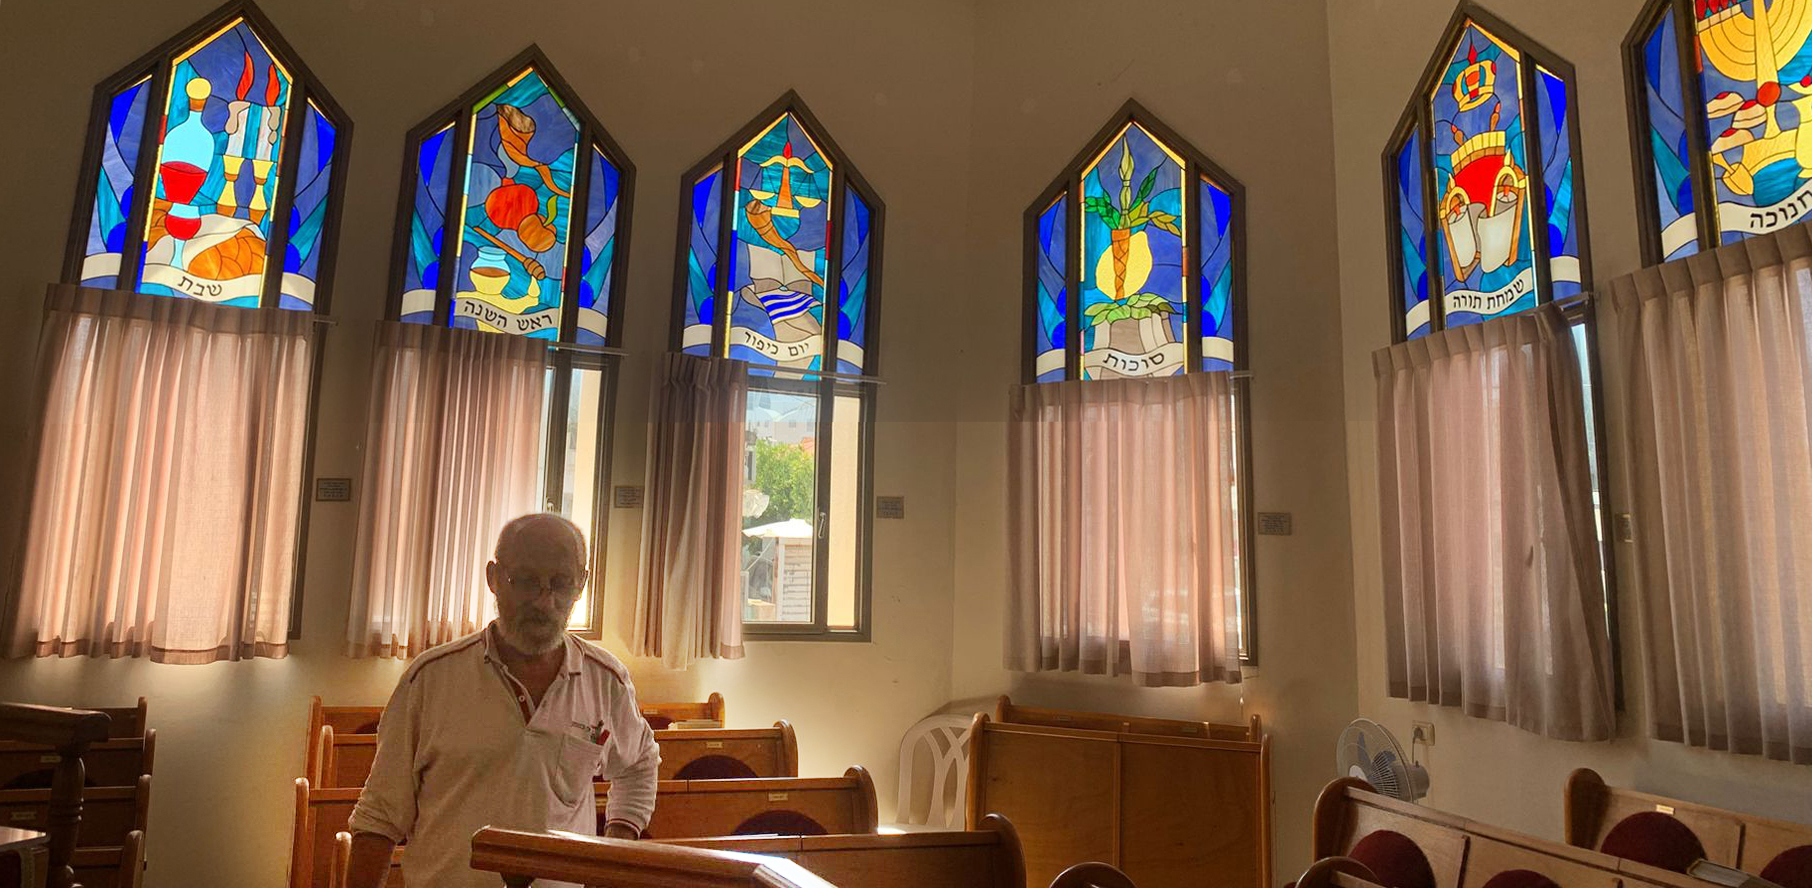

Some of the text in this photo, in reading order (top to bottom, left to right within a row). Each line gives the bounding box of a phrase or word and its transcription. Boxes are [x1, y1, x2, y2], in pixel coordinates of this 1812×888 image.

[177, 276, 223, 297] שבת
[1453, 279, 1524, 310] שמחת תורה
[464, 301, 553, 331] ראש השנה
[744, 331, 809, 356] יום כיפור
[1103, 353, 1164, 371] סוכות
